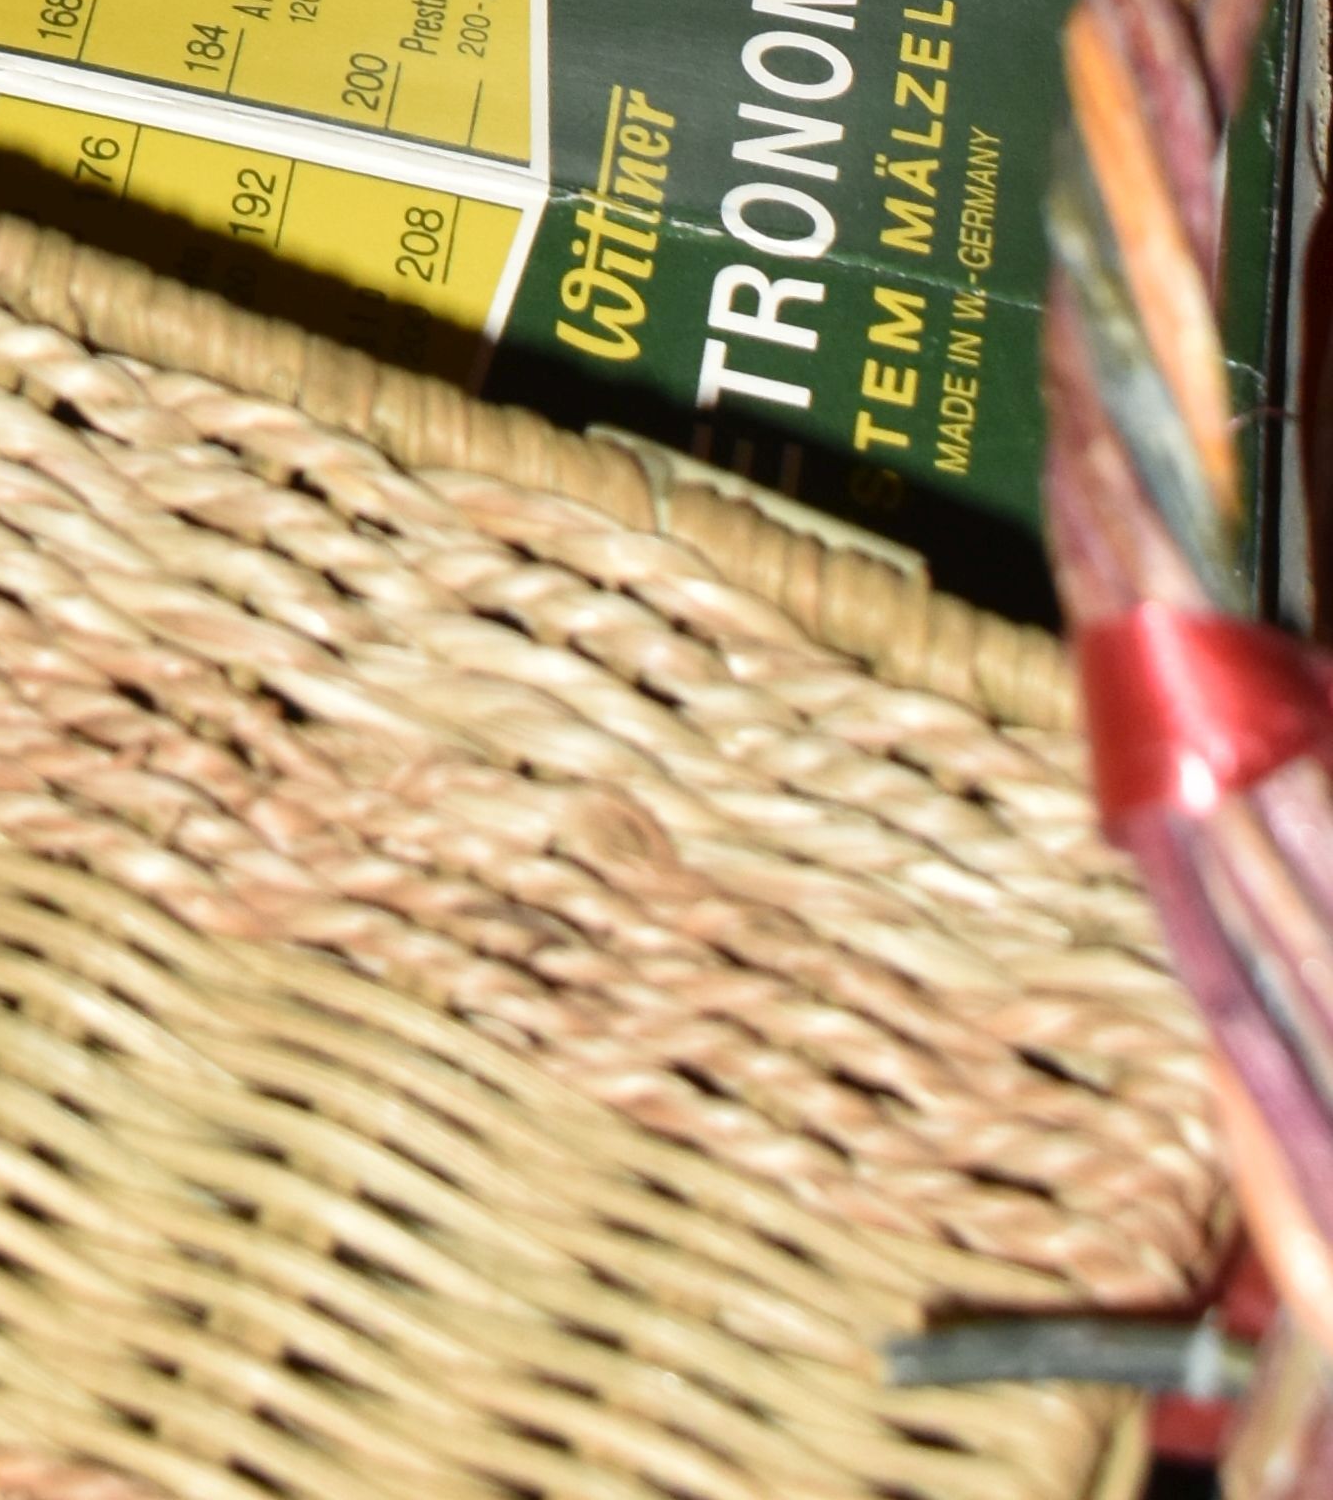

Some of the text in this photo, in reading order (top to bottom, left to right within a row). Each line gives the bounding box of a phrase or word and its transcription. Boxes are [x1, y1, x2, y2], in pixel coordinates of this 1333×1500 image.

[183, 23, 229, 72] 184
[341, 53, 389, 112] 200
[874, 0, 956, 255] MÄLZEL
[228, 167, 276, 236] 192
[555, 83, 677, 362] Wittner
[395, 206, 445, 284] 208
[934, 370, 979, 477] MADE
[959, 330, 985, 368] IN
